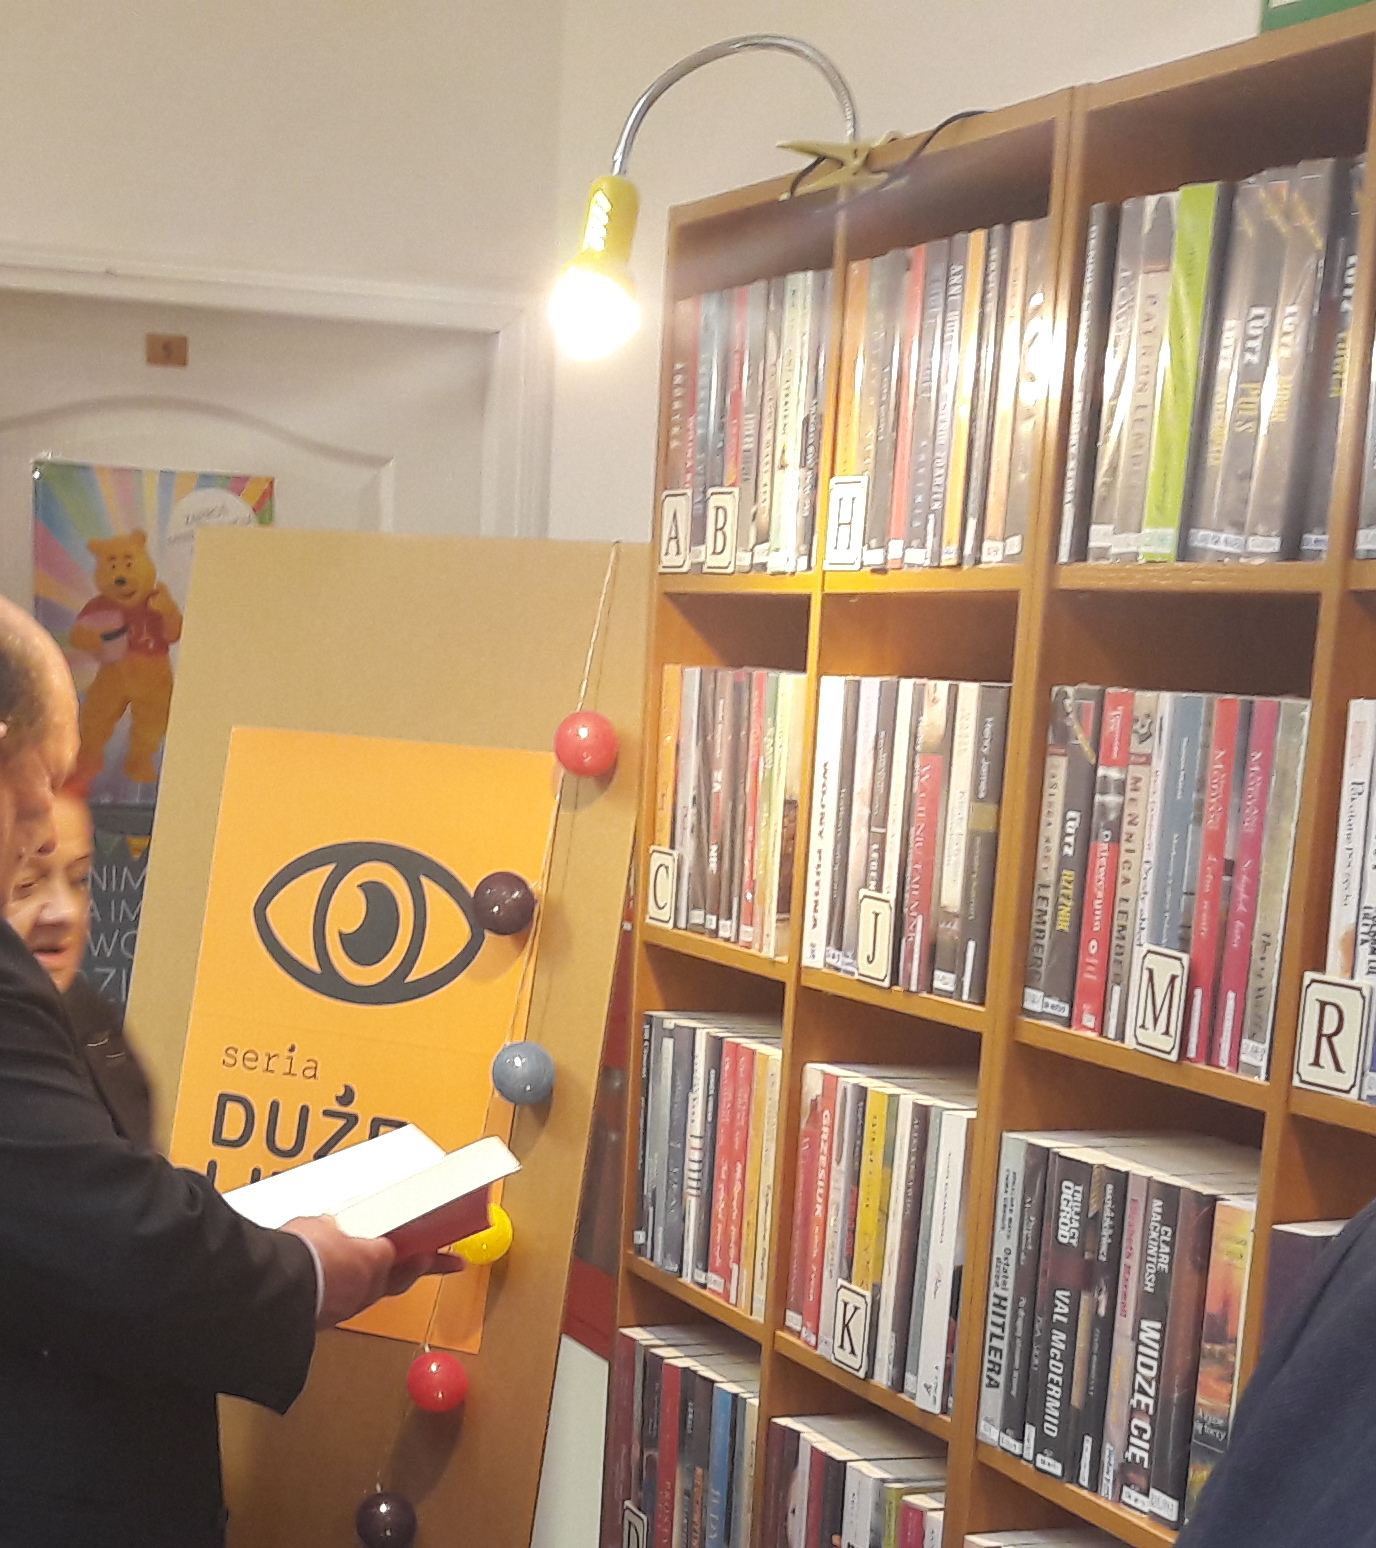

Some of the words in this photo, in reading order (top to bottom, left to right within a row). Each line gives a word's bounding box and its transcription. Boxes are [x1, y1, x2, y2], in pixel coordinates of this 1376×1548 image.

[664, 508, 683, 557] A
[712, 505, 728, 556] B
[833, 496, 857, 550] H
[653, 861, 670, 912] C
[866, 910, 883, 965] J
[1137, 966, 1180, 1040] M
[222, 1043, 321, 1081] seria
[1308, 998, 1347, 1077] R
[1142, 1198, 1165, 1293] MACKINTOSH
[1156, 1225, 1174, 1275] CLARE
[837, 1299, 862, 1358] K
[1051, 1288, 1072, 1325] VAL
[984, 1292, 1009, 1390] HITLERA
[1129, 1319, 1163, 1415] WIDZĘ
[1042, 1329, 1066, 1440] McDERMID
[1123, 1416, 1153, 1470] CIĘ
